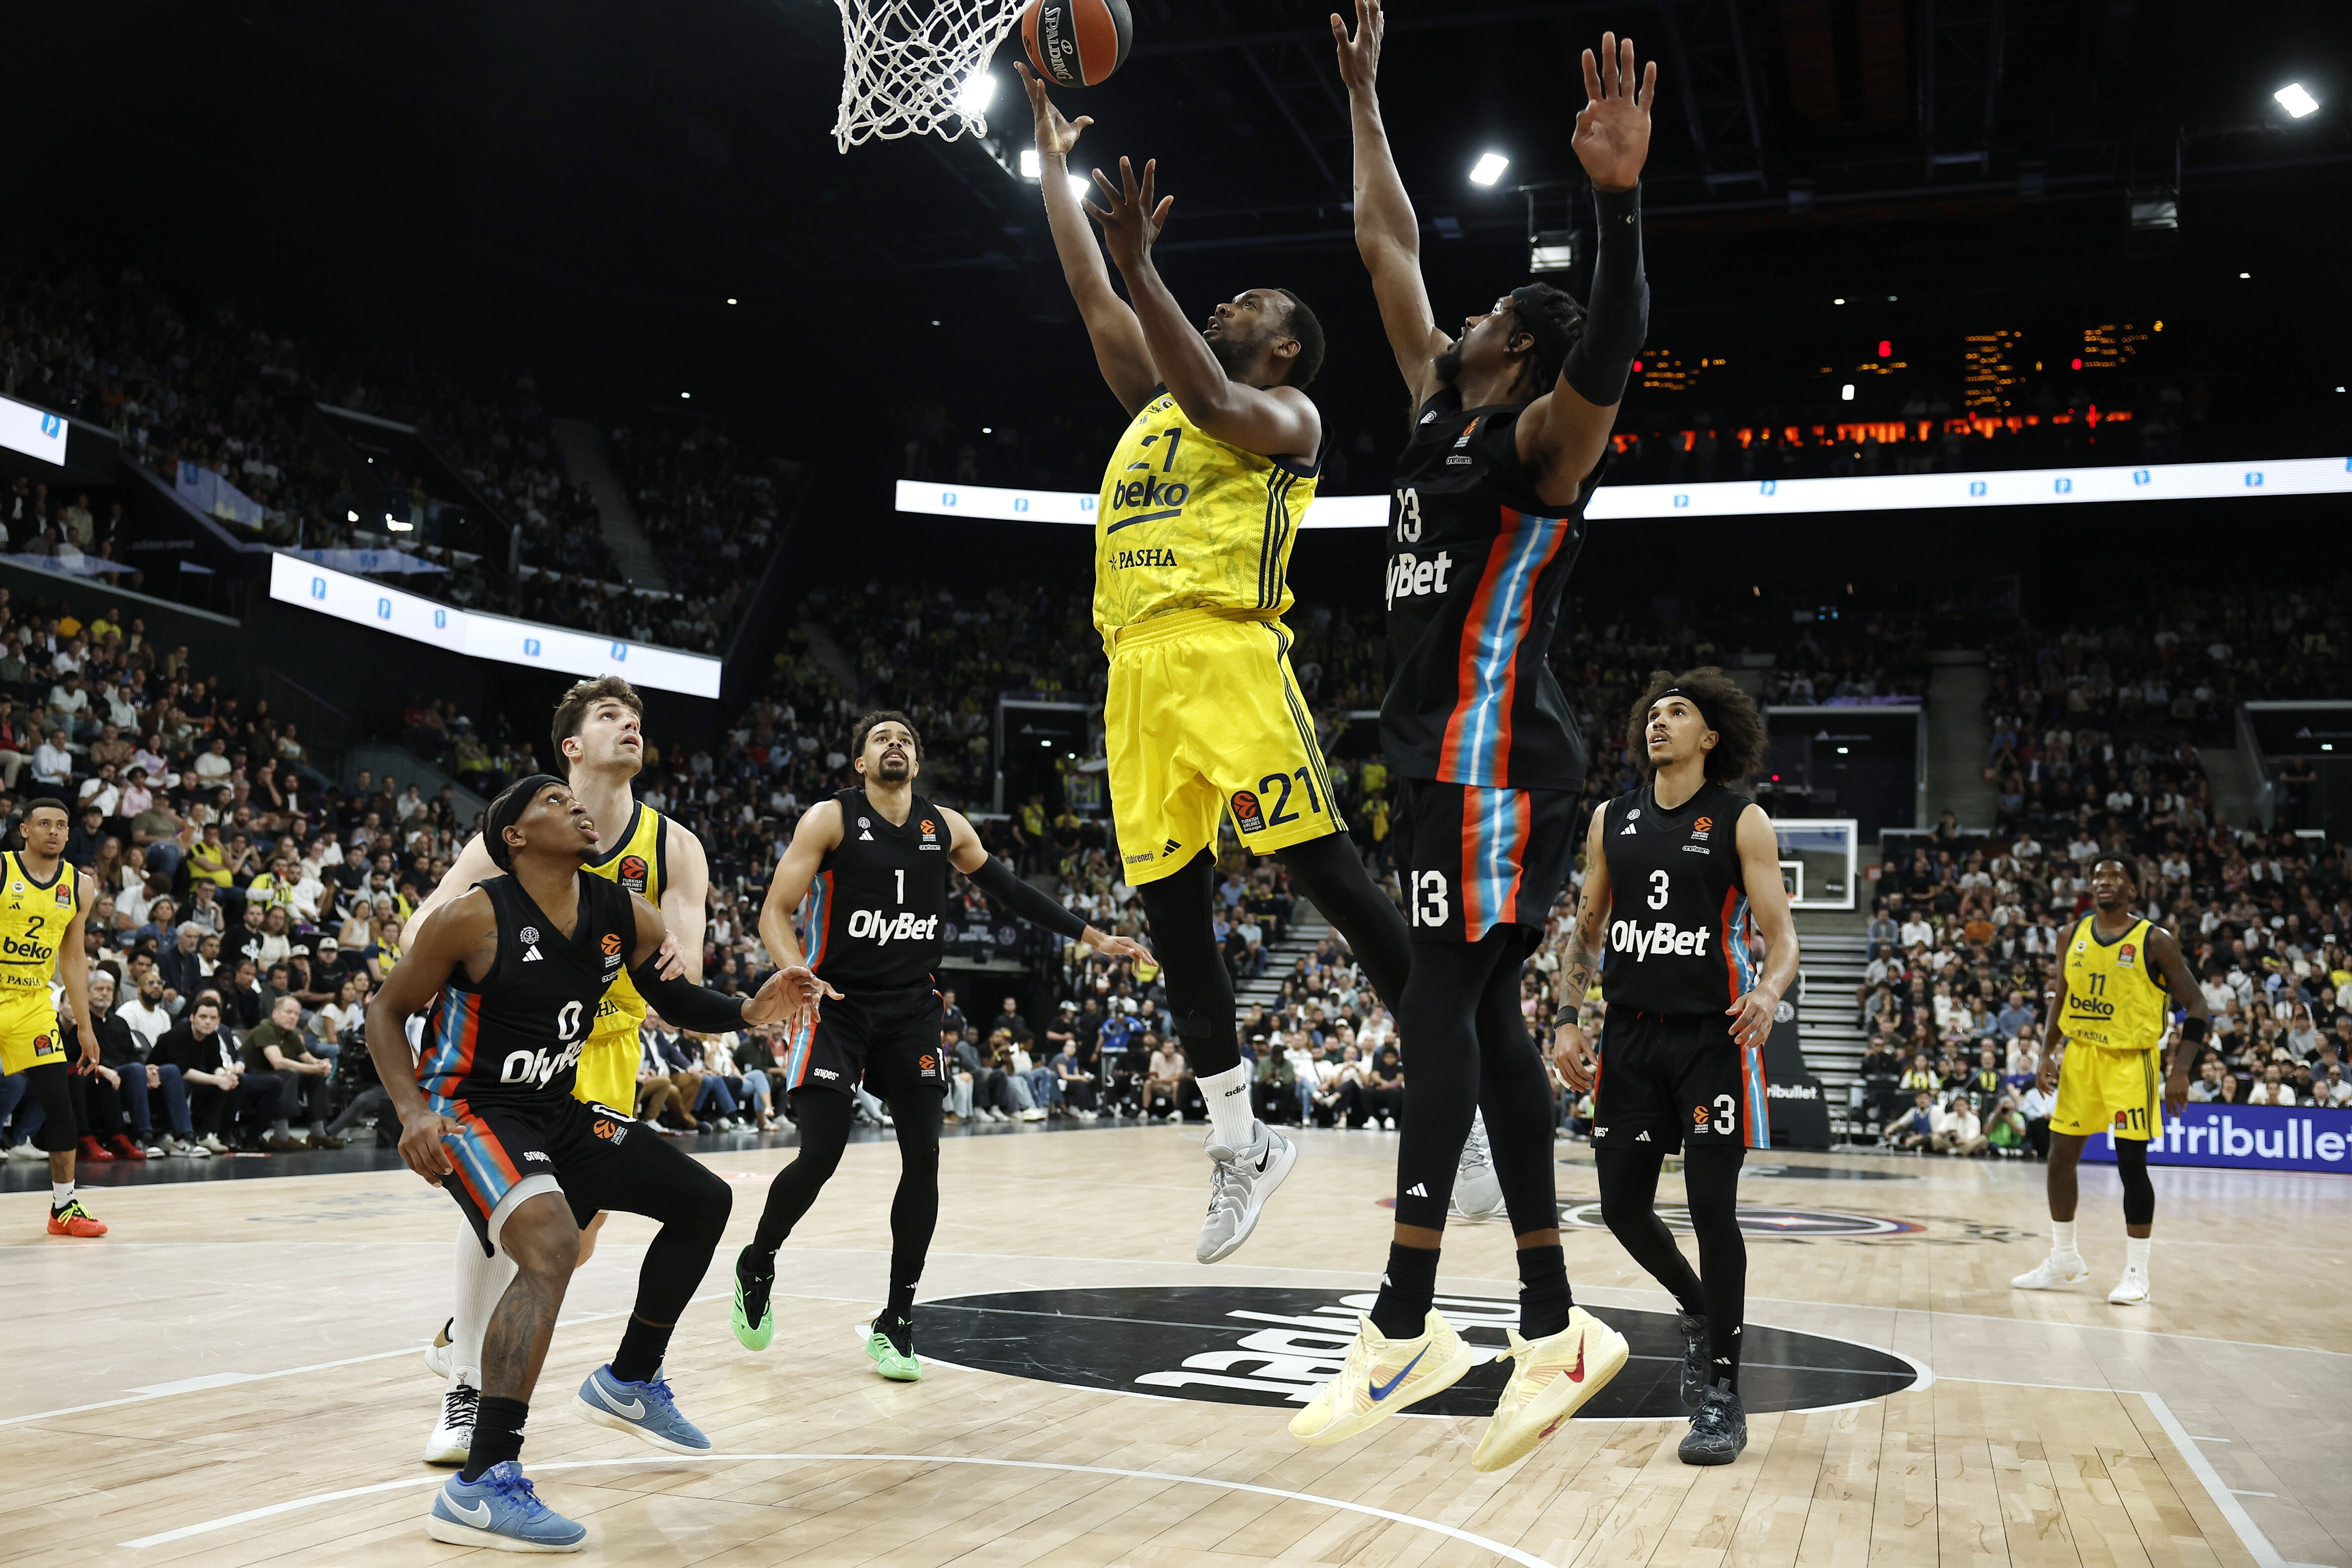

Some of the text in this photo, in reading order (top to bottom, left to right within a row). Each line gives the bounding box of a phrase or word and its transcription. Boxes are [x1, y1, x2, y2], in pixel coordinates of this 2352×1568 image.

[1045, 7, 1073, 80] SPALDING
[1113, 475, 1189, 510] beko
[1397, 488, 1421, 543] 13
[1119, 549, 1177, 569] PASHA
[1386, 550, 1452, 611] lyBet
[1259, 766, 1321, 826] 21
[1682, 845, 1710, 855] oneteam
[895, 870, 904, 904] 1
[1411, 870, 1449, 927] 13
[1647, 870, 1669, 910] 3
[25, 916, 45, 939] 2
[848, 910, 938, 946] OlyBet
[1611, 919, 1711, 962] OlyBet
[3, 937, 52, 959] beko
[7, 975, 40, 987] PASHA
[2089, 973, 2106, 996] 11
[558, 1001, 583, 1040] 0
[2070, 994, 2114, 1014] beko
[500, 1040, 587, 1090] OlyBe
[814, 1068, 836, 1080] snipes
[936, 1047, 945, 1081] 1
[1225, 1083, 1246, 1097] adid
[1767, 1084, 1817, 1099] ribullet
[1714, 1094, 1735, 1135] 3
[2127, 1108, 2146, 1130] 11
[2107, 1114, 2352, 1162] tribulle
